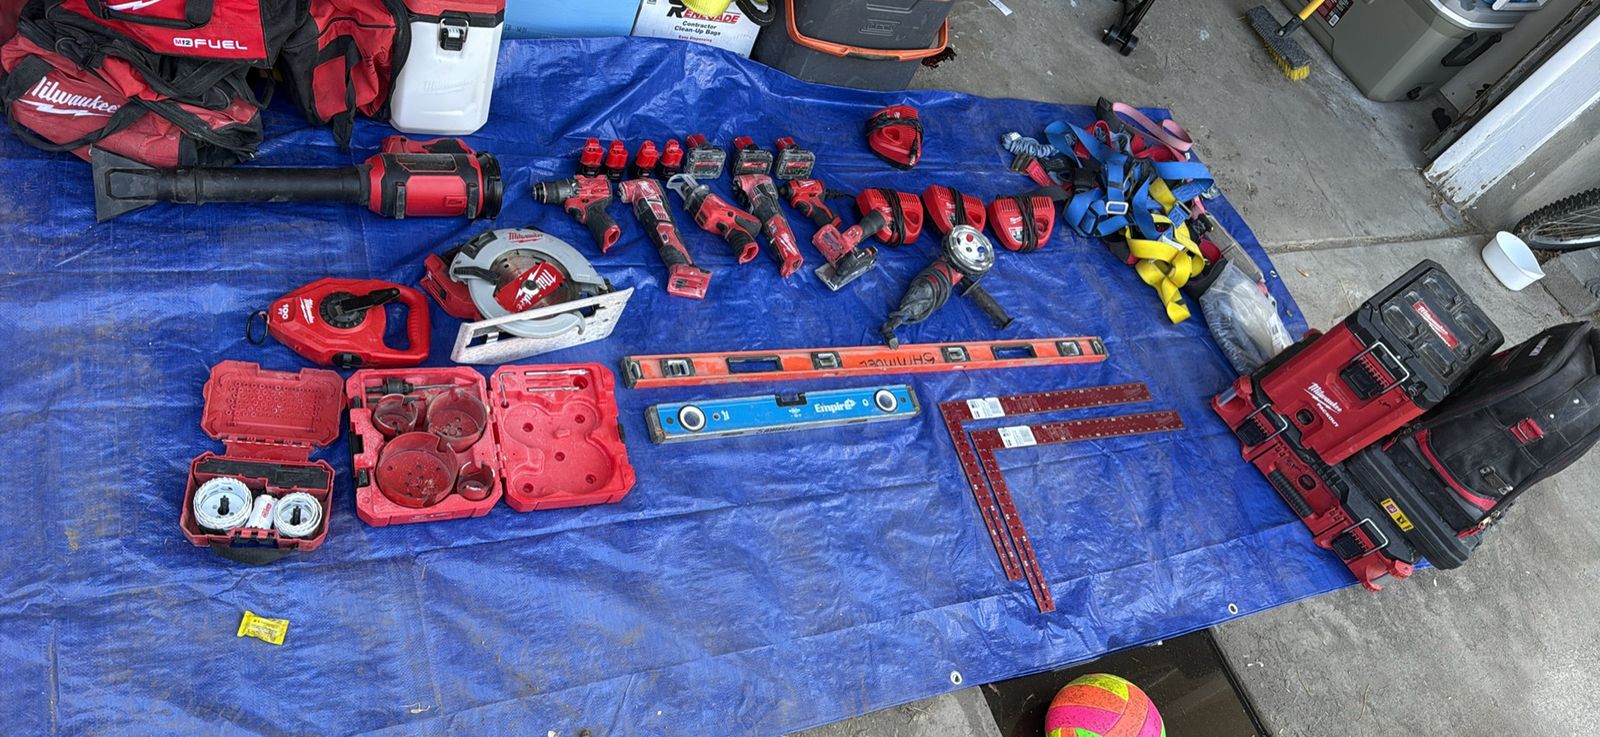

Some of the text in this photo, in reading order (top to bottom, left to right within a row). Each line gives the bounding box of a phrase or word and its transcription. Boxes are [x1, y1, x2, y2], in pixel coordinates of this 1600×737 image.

[682, 20, 717, 29] Contractor
[674, 25, 704, 34] Clean-Up
[194, 39, 248, 50] FUEL
